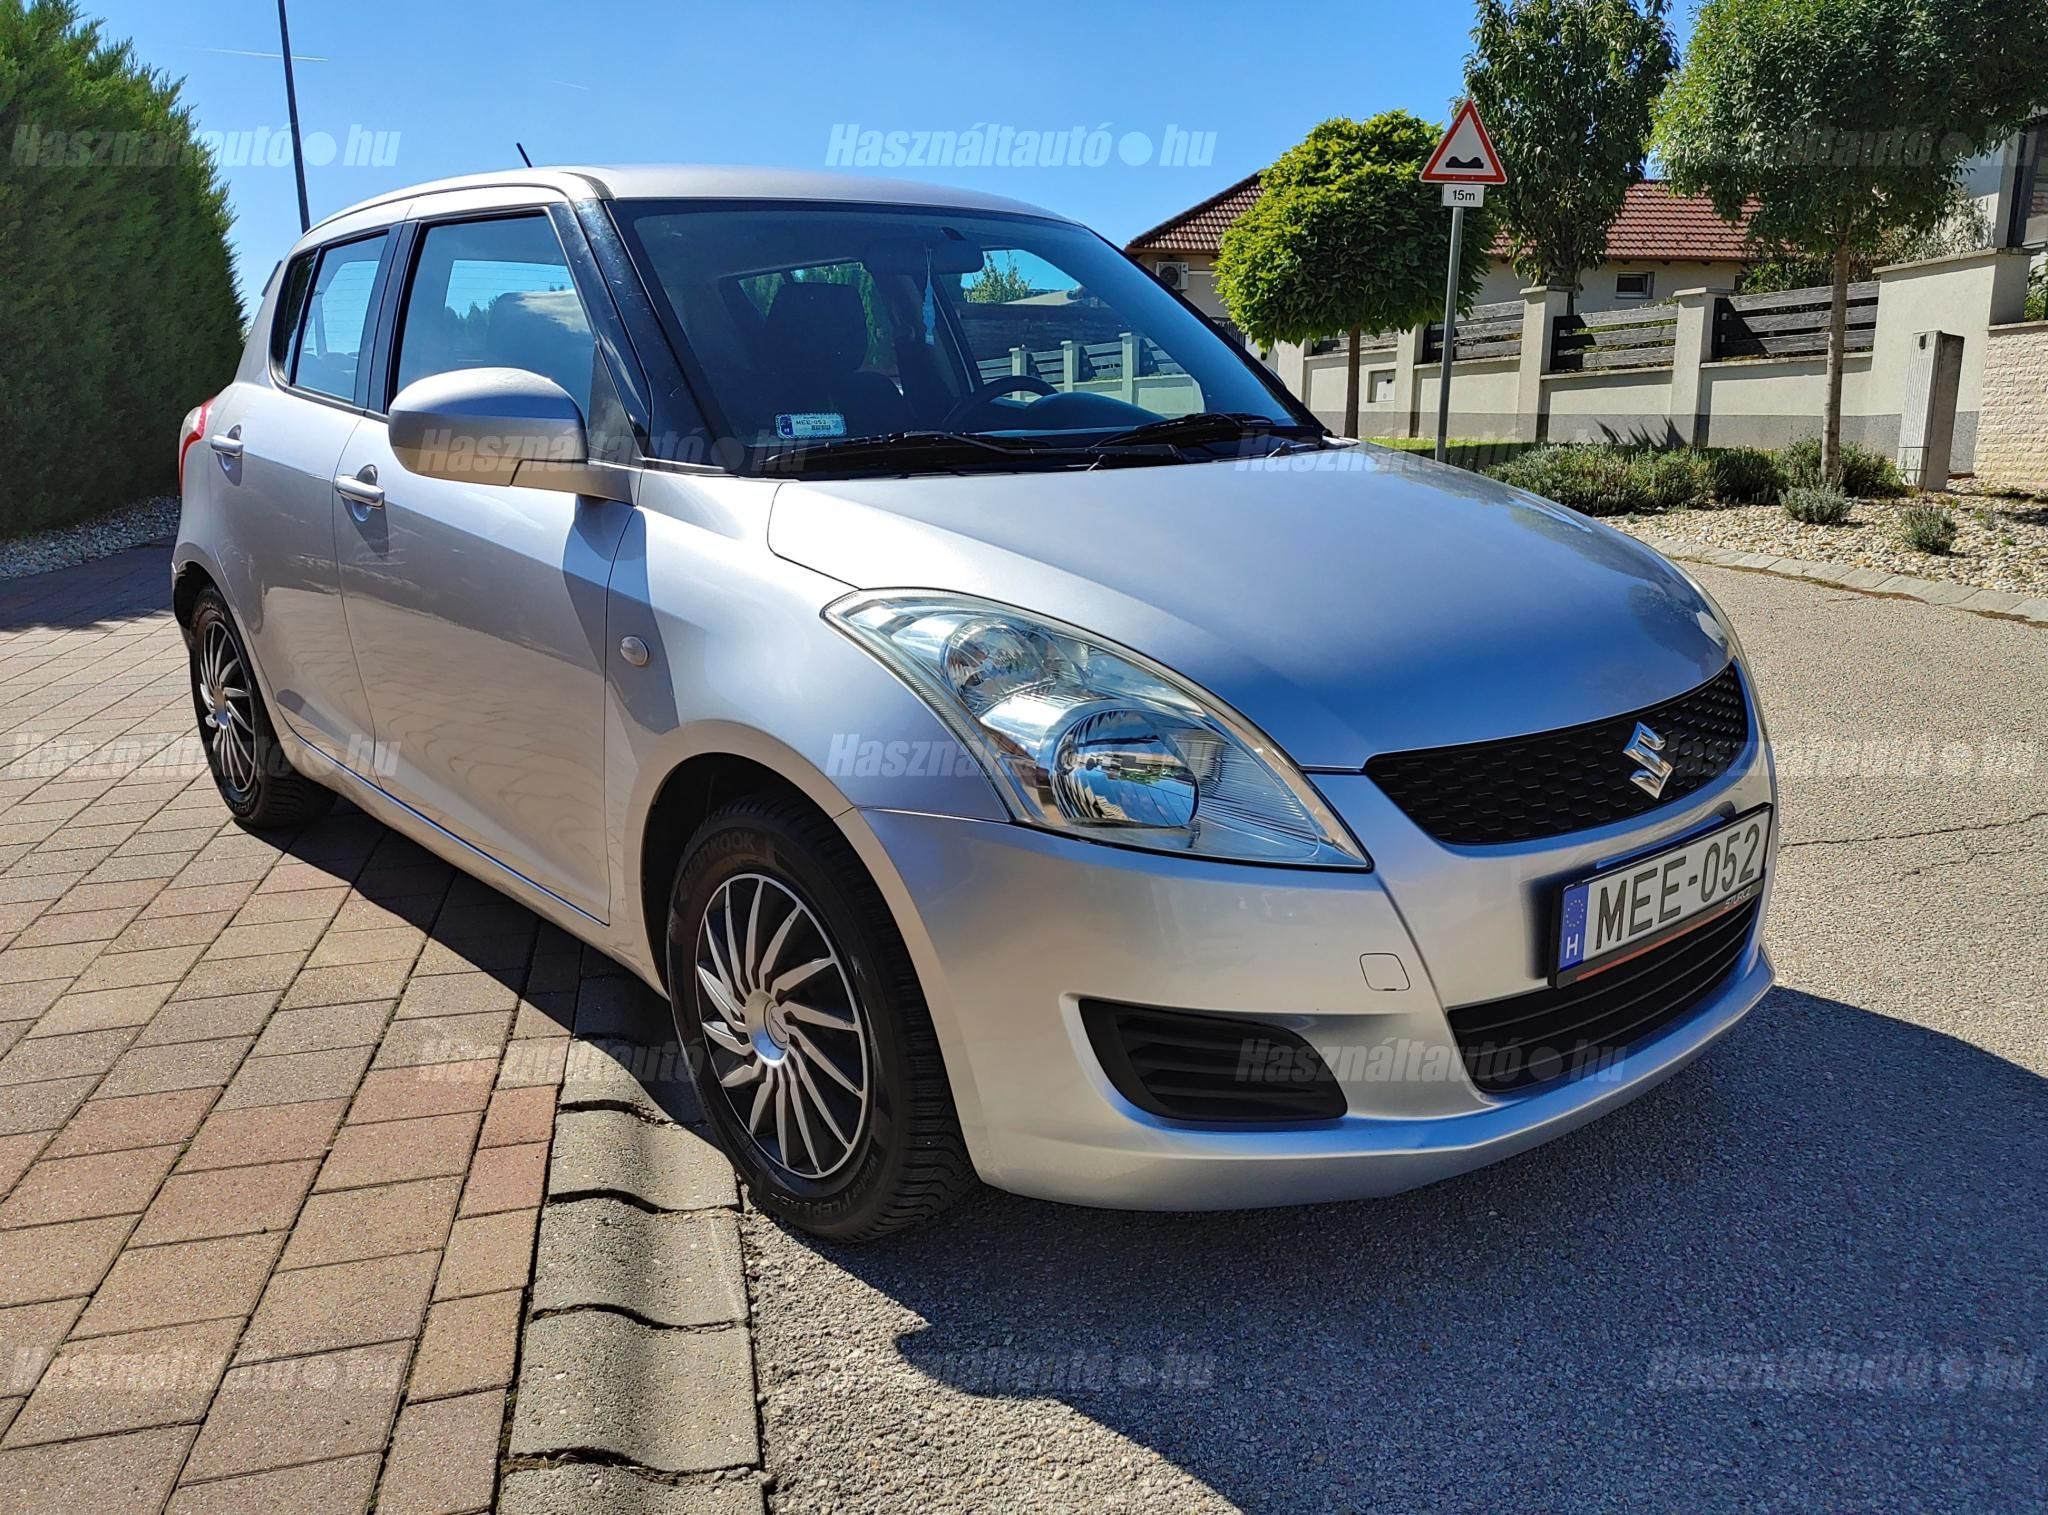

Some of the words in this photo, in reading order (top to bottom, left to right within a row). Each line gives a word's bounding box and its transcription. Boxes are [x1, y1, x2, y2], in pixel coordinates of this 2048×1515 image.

[1452, 189, 1475, 201] 15m
[1595, 823, 1760, 950] MEE-052
[1565, 933, 1579, 959] H
